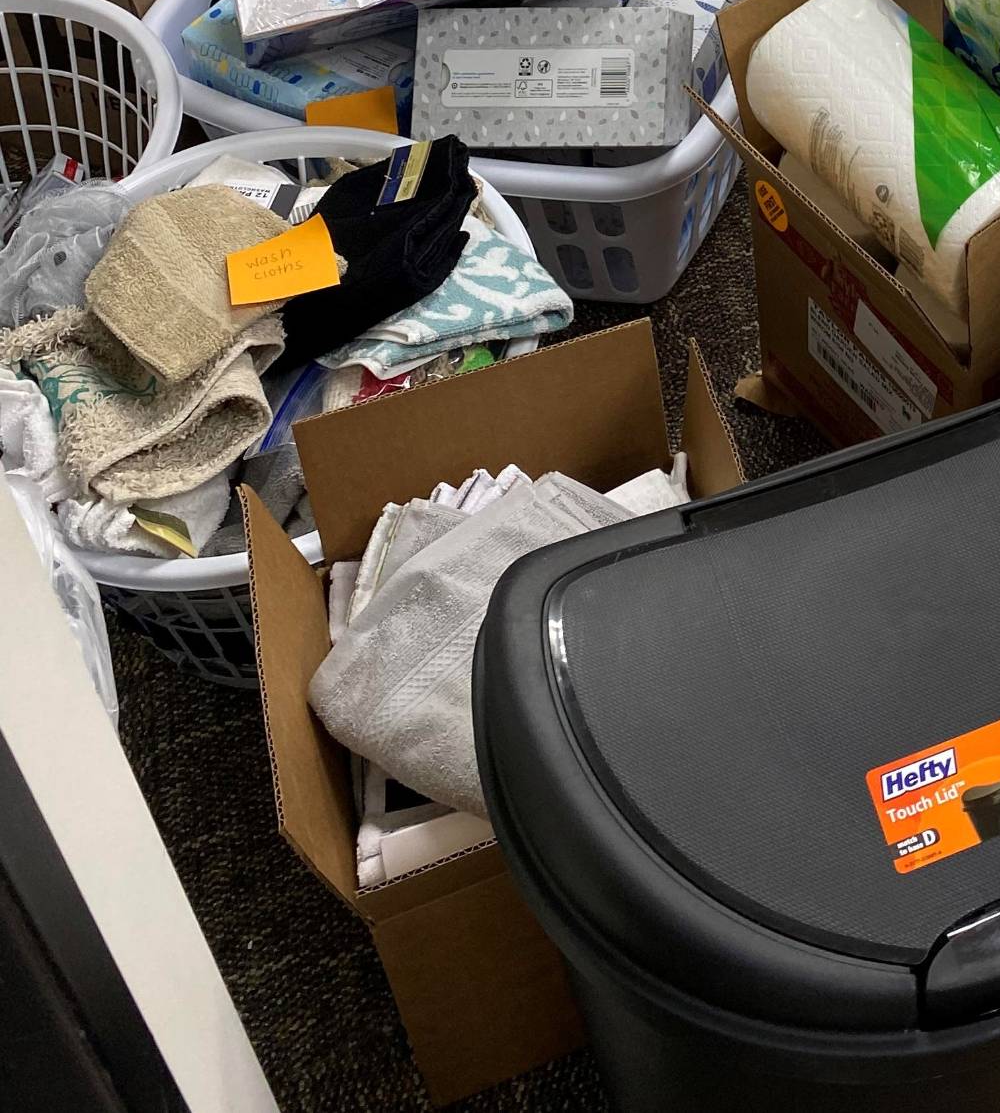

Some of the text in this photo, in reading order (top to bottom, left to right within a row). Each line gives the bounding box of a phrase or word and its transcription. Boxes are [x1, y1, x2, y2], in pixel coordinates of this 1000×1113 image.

[246, 248, 292, 269] wash
[254, 261, 304, 280] cloths
[885, 758, 952, 796] Hefty
[886, 797, 933, 823] Touch
[922, 829, 937, 846] D
